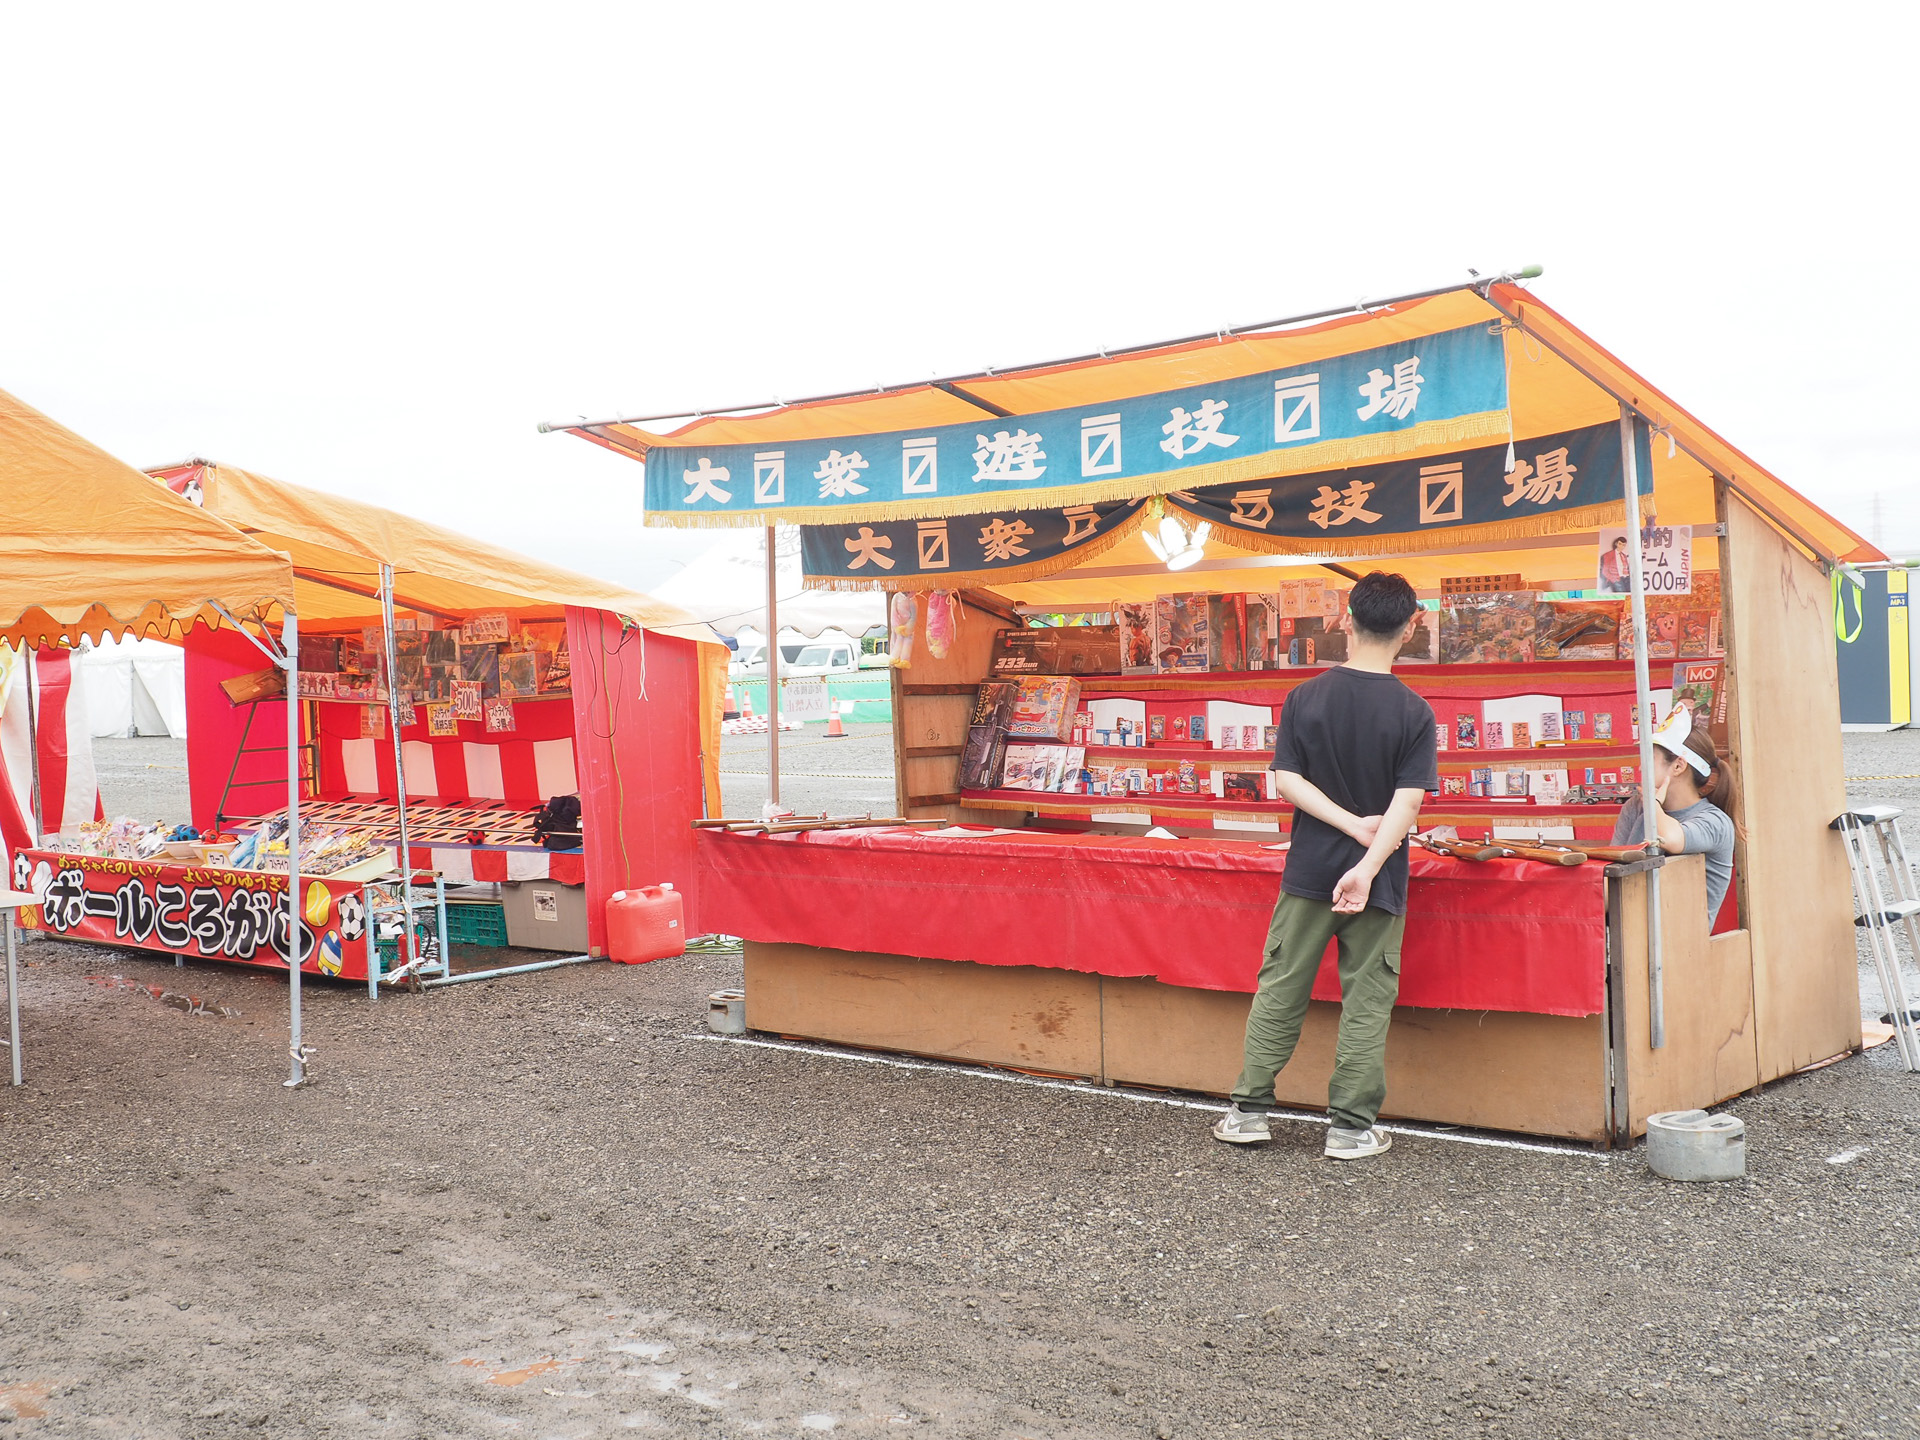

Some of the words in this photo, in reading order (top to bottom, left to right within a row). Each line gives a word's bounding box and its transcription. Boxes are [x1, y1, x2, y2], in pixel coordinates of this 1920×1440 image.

[844, 446, 1577, 570] 大衆技場
[490, 706, 510, 717] ストライク
[58, 854, 163, 878] めっちゃたのしい!
